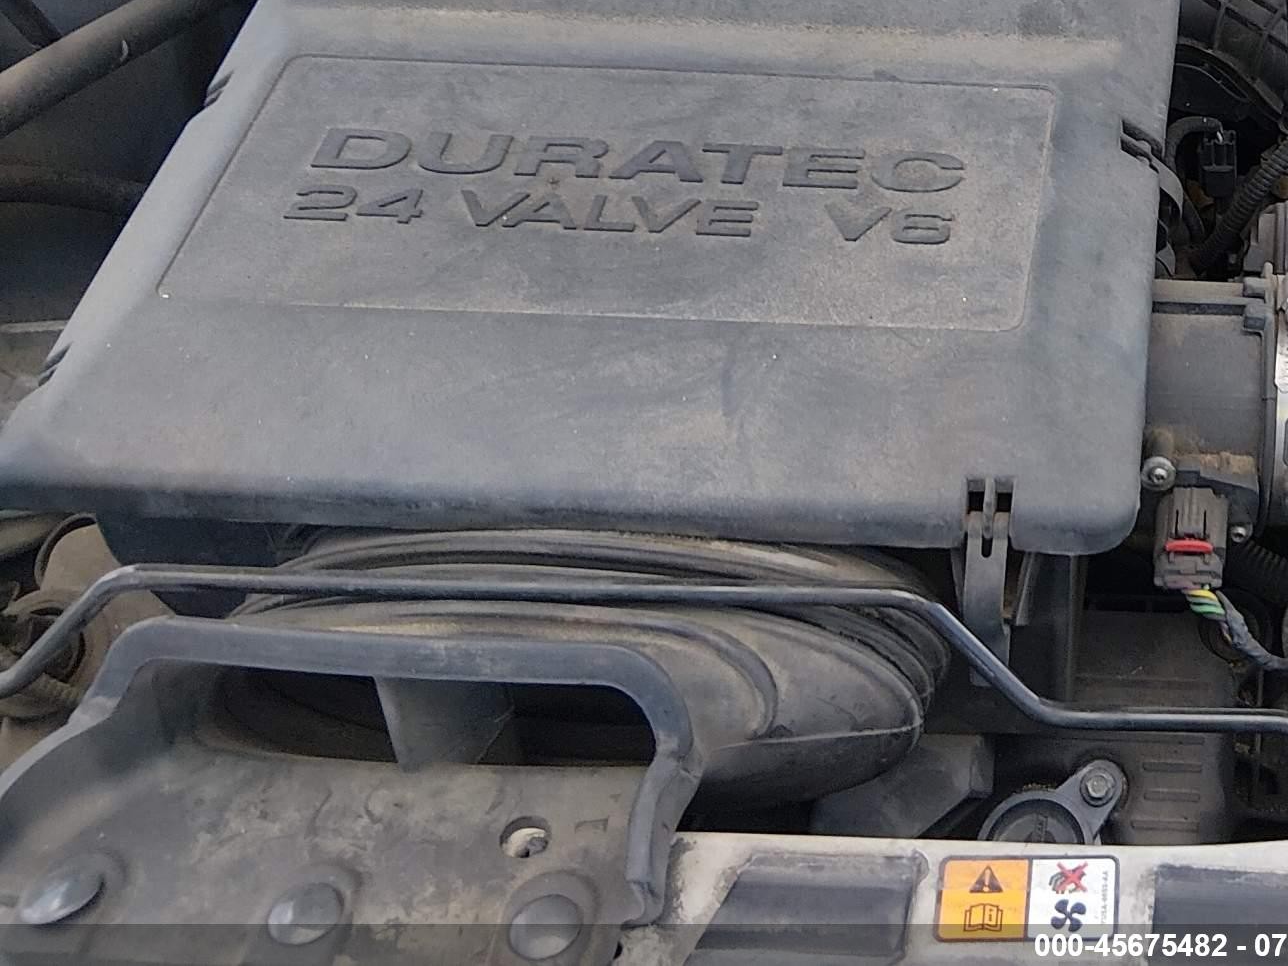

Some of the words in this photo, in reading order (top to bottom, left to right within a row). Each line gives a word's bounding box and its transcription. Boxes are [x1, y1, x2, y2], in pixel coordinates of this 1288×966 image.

[309, 126, 967, 195] DURATEC
[282, 183, 425, 226] 24
[462, 189, 761, 239] VALVE
[823, 202, 956, 246] V6
